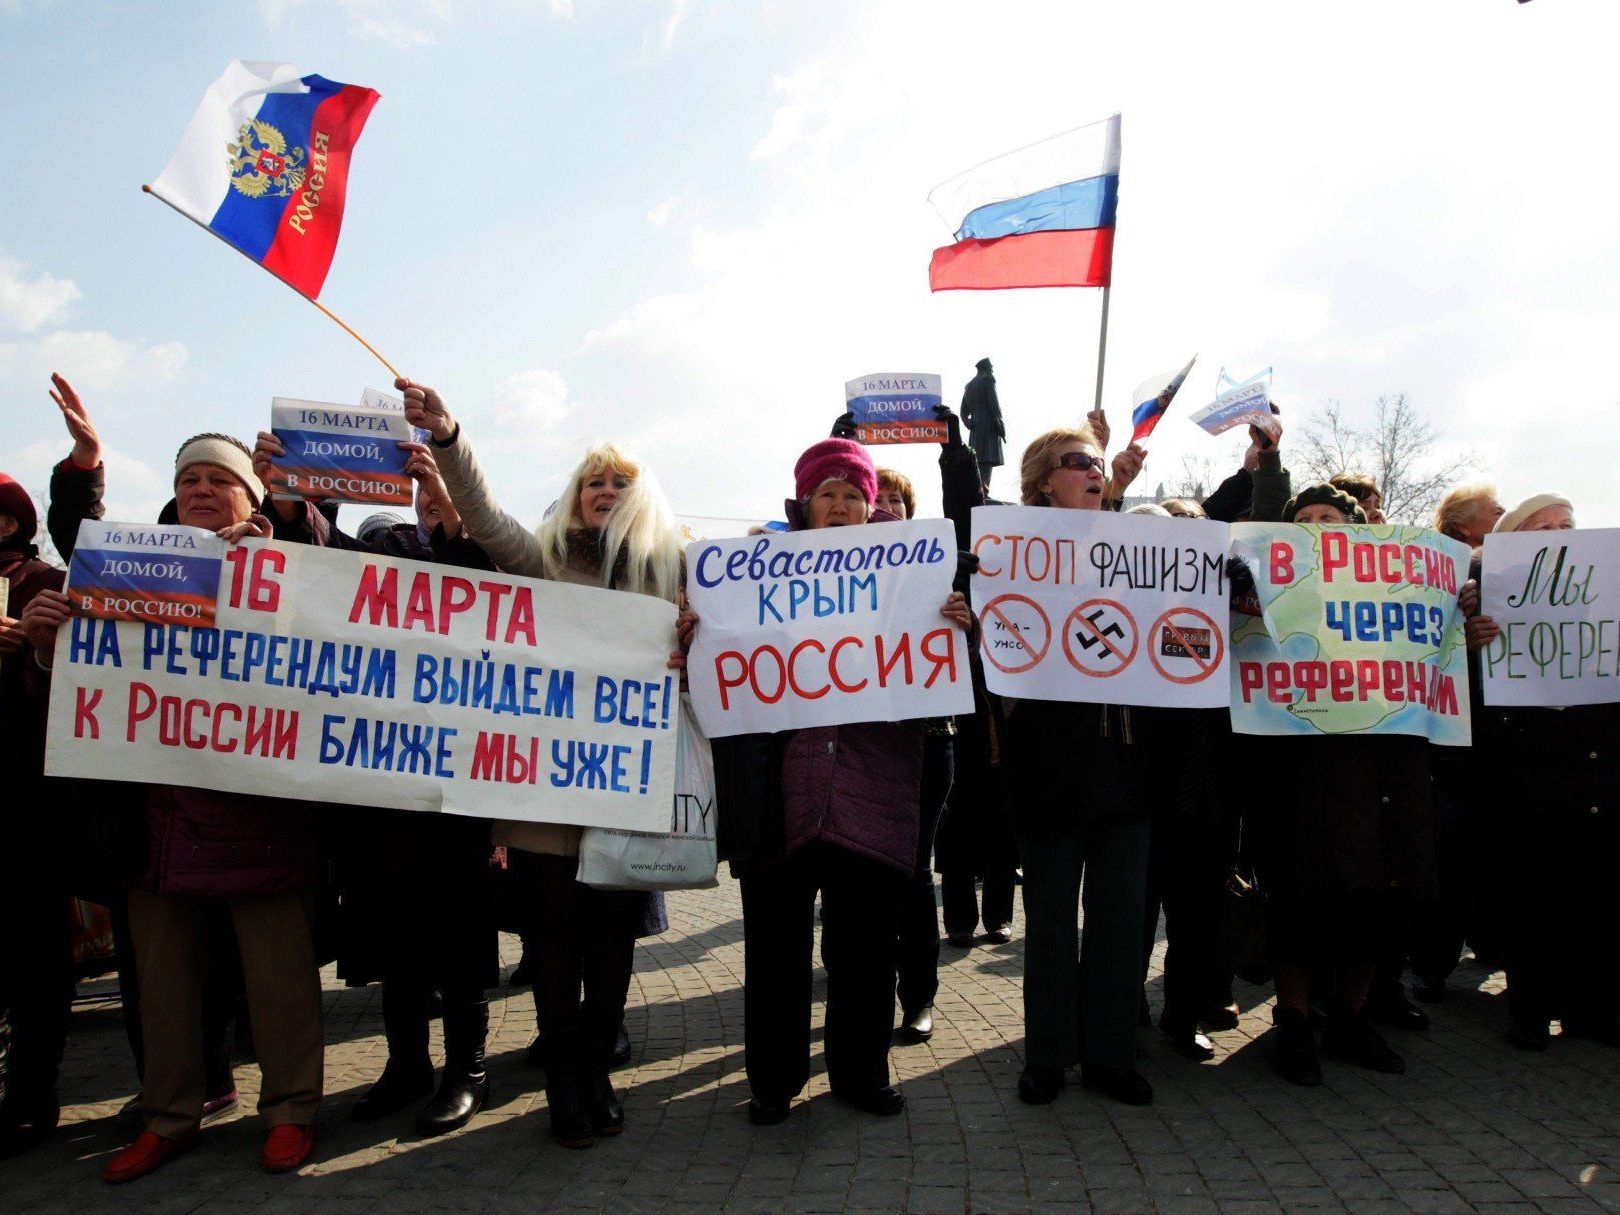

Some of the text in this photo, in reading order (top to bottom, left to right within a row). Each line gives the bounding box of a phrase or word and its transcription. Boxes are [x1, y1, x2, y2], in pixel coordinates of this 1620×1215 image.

[289, 130, 330, 235] РОССИЯ
[863, 379, 927, 391] 16 МАРТА
[299, 410, 389, 431] 16 МАРТА
[867, 399, 926, 414] ДОМОЙ,
[858, 427, 938, 440] В РОССИЮ!
[303, 440, 384, 462] ДОМОЙ,
[287, 474, 400, 495] В РОССИЮ!
[104, 531, 196, 548] 16 МАРТА
[101, 559, 188, 582] ДОМОЙ,
[695, 537, 945, 588] Севастополь
[973, 534, 1224, 596] СТОП ФАШИЗМ
[1507, 545, 1598, 608] Мы
[81, 595, 201, 618] В РОССИЮ!
[225, 544, 538, 647] 16 МАРТА
[759, 572, 878, 625] КРЫМ
[1165, 644, 1204, 654] СЕКР
[1486, 620, 1620, 679] РЕФЕРЕ
[69, 617, 673, 730] НА РЕФЕРЕНДУМ ВЫЙДЕМ ВСЕ!
[715, 627, 956, 710] РОССИЯ
[74, 686, 103, 739] К
[319, 714, 458, 779] БЛИЖЕ
[469, 731, 539, 785] МЫ
[674, 793, 712, 834] ITY
[630, 862, 686, 873] www.incity.ru
